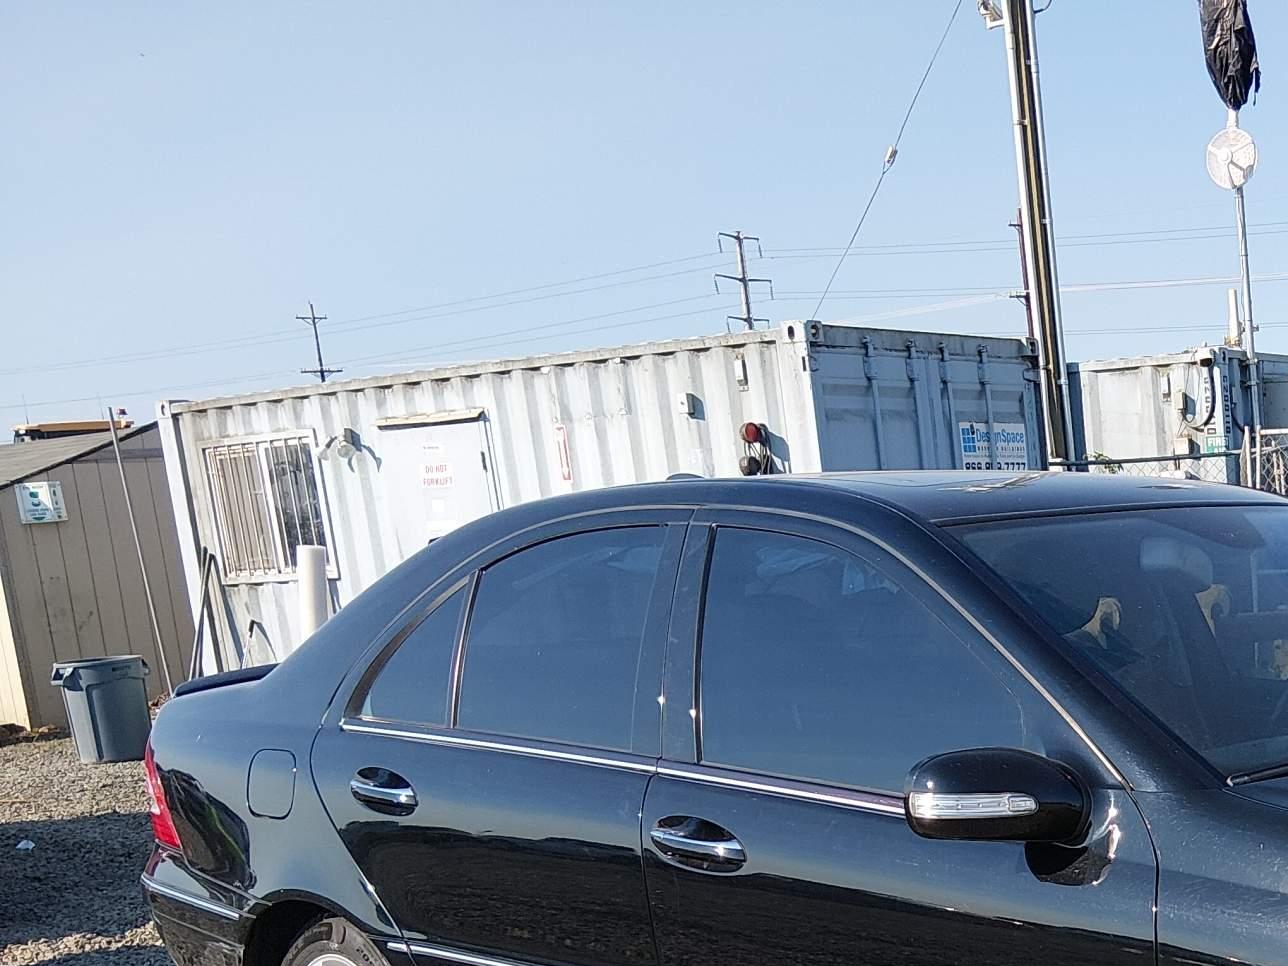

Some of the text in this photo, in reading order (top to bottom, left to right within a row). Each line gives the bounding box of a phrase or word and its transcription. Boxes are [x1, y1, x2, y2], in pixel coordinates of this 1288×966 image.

[975, 428, 1025, 446] DesgnSpace
[425, 464, 447, 473] DO NOT
[423, 476, 453, 487] FORKLIFT
